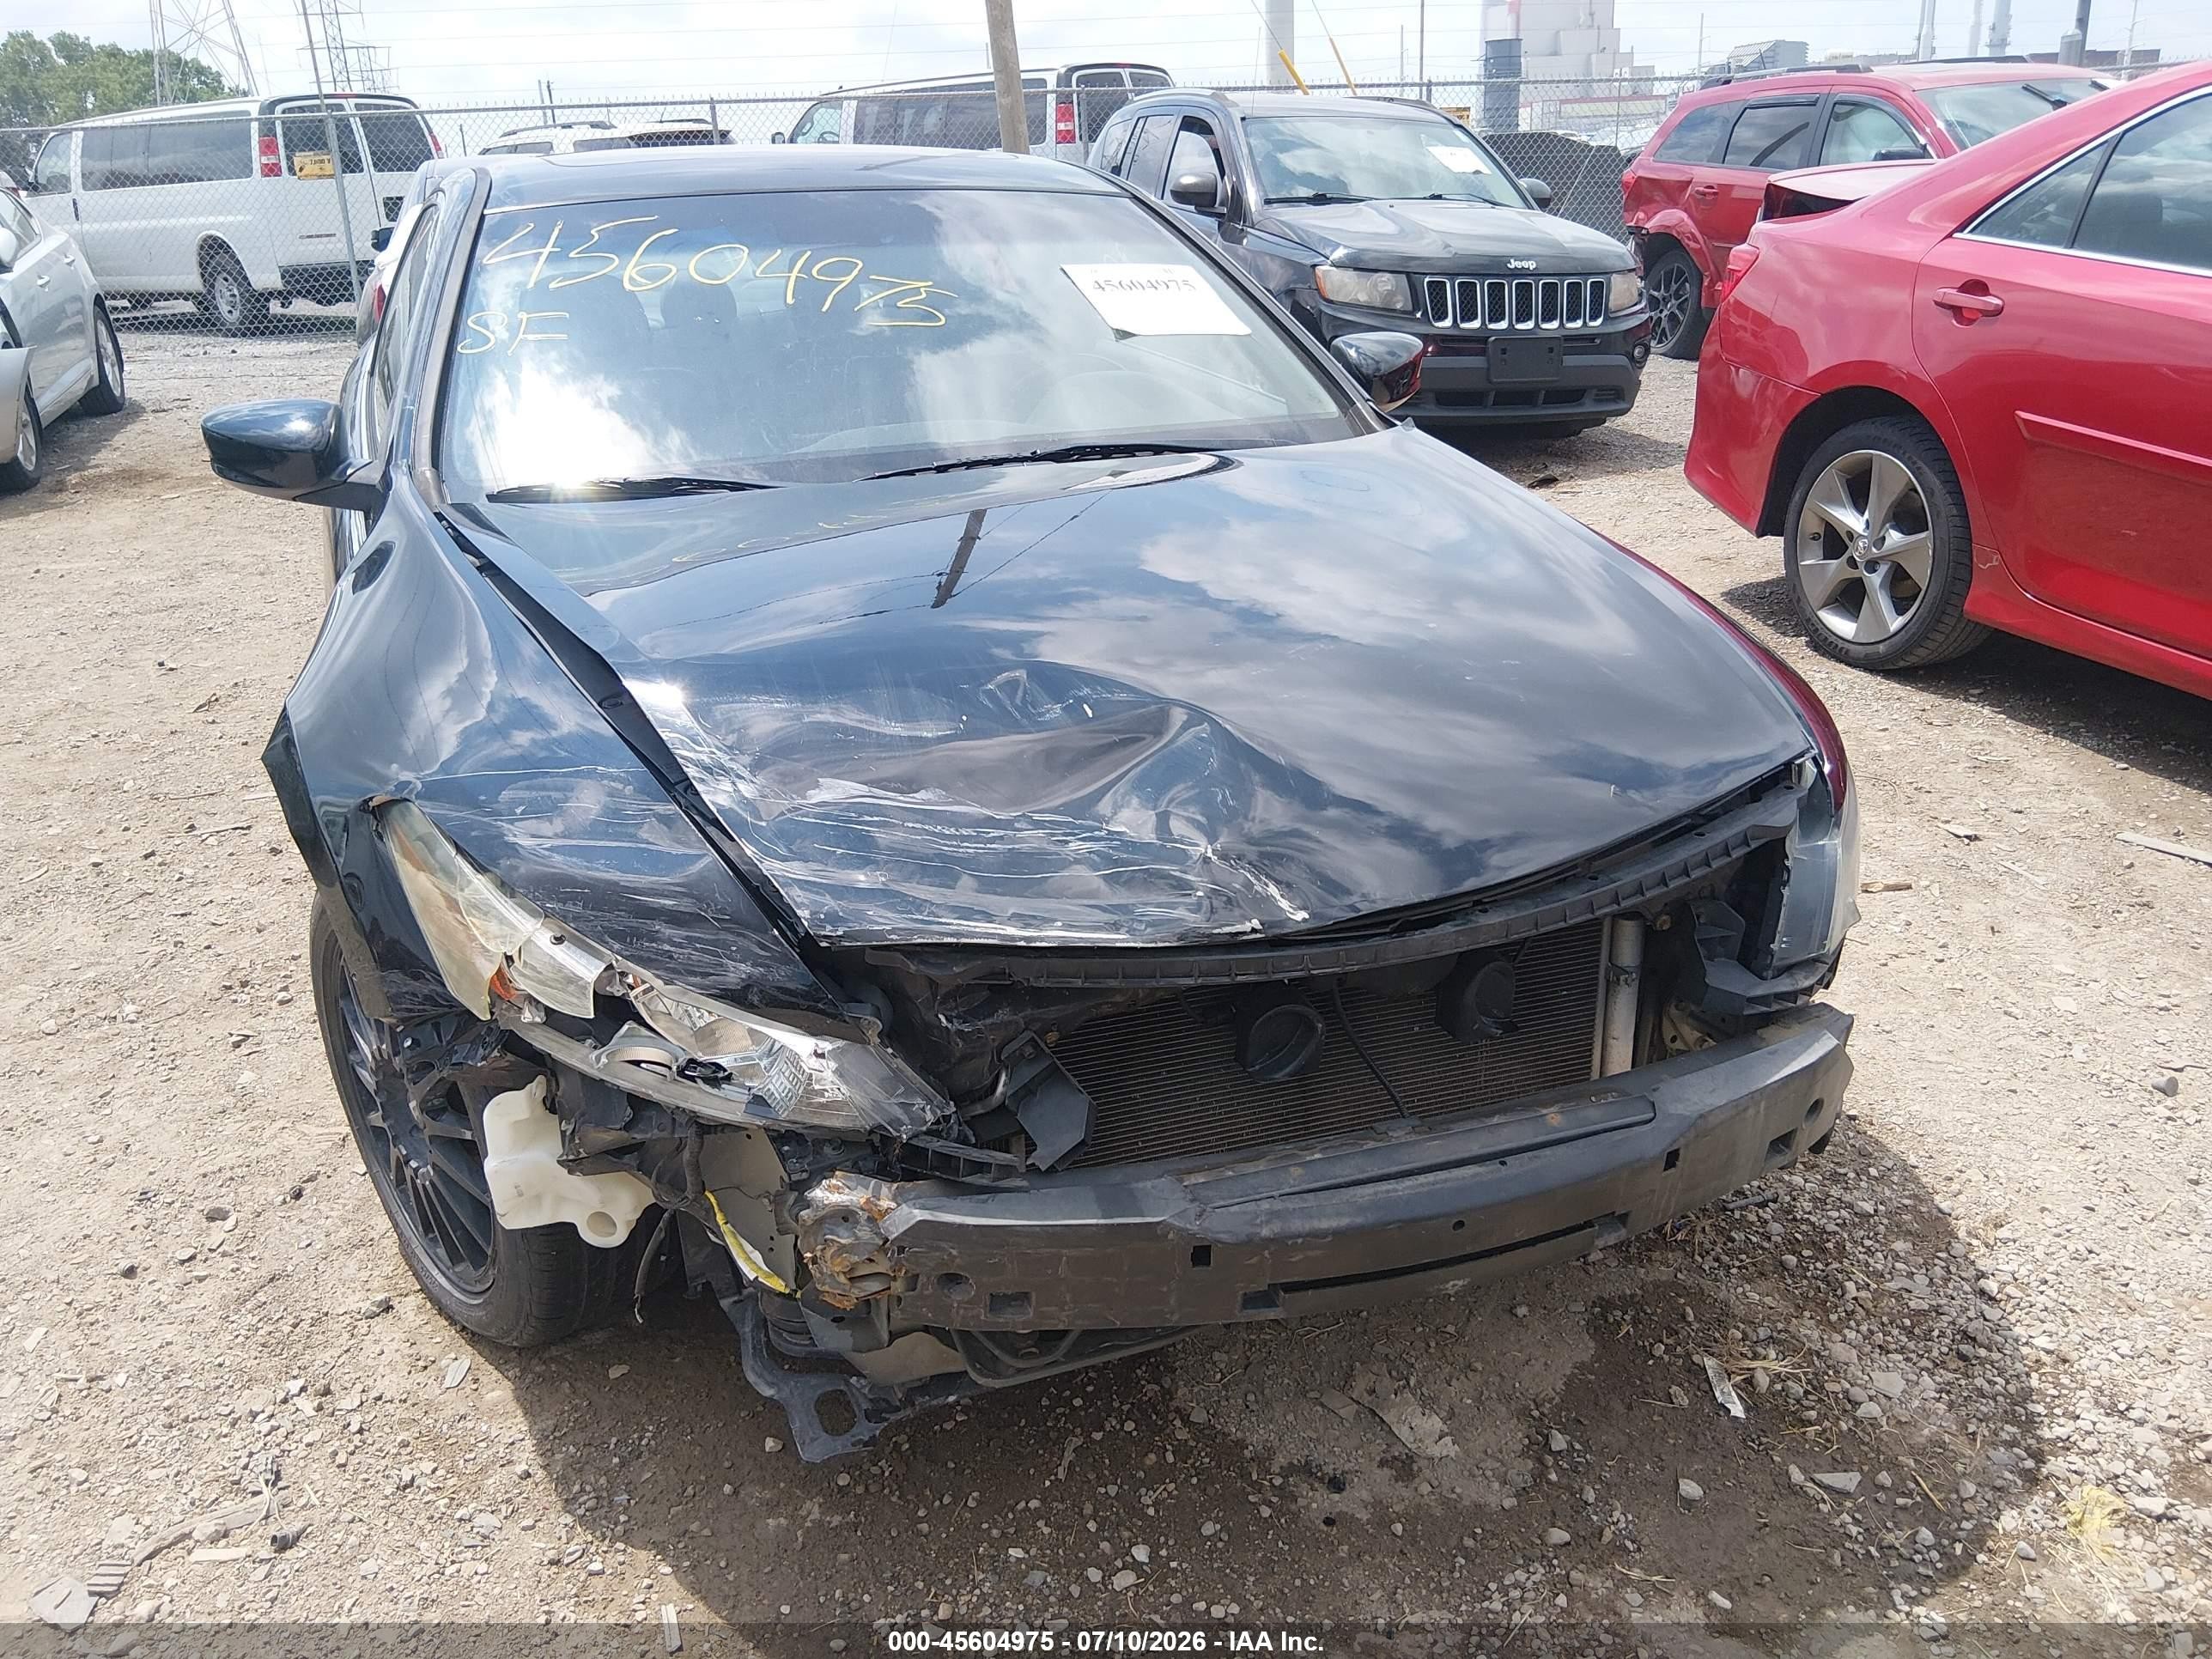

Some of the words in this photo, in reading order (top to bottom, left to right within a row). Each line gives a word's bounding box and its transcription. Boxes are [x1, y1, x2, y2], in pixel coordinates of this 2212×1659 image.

[483, 215, 959, 327] 45604975
[1506, 258, 1536, 270] Jeep
[457, 311, 569, 356] SF
